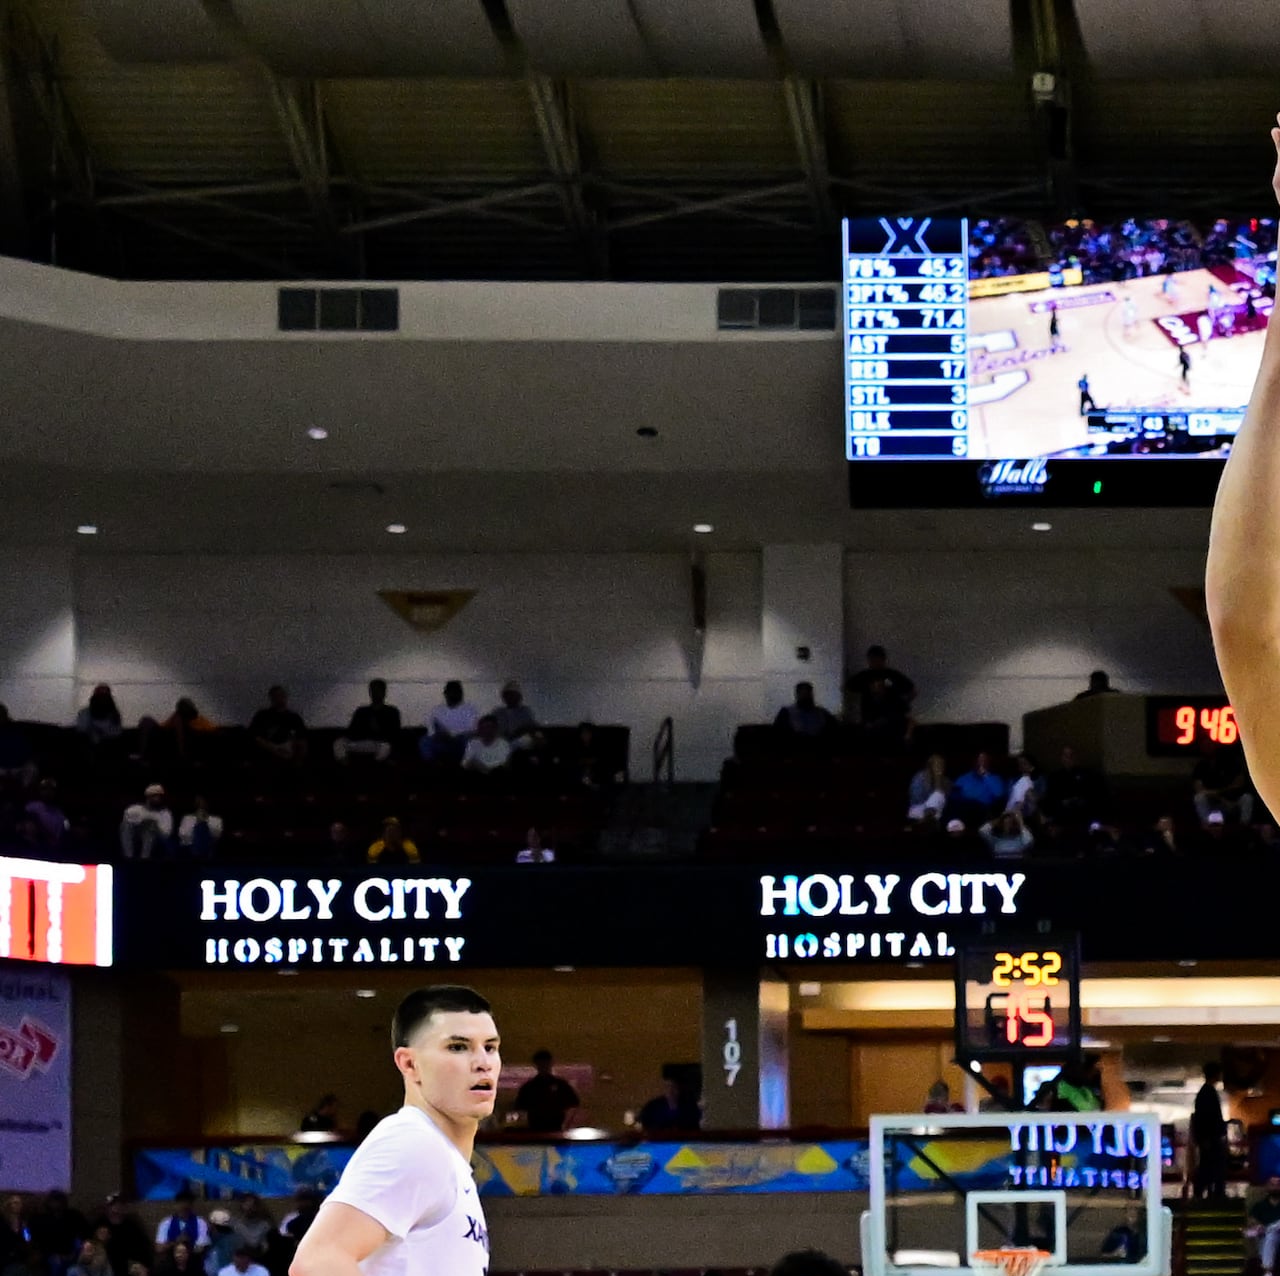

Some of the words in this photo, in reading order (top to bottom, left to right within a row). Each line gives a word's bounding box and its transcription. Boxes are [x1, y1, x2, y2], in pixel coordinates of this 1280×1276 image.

[919, 259, 964, 278] 45.2
[919, 285, 964, 304] 46.2
[921, 310, 965, 329] 71.4
[851, 335, 889, 354] AST
[951, 335, 965, 354] 5
[941, 361, 965, 379] 17
[852, 386, 890, 405] STL
[951, 386, 965, 405] 3
[952, 411, 966, 430] 0
[952, 437, 967, 456] 5
[201, 878, 342, 922] HOLY
[354, 876, 472, 921] CITY
[760, 873, 900, 917] HOLY
[910, 872, 1026, 916] CITY
[205, 936, 465, 965] HOSPITALITY
[766, 931, 956, 959] HOSPITAL
[993, 952, 1061, 987] 2:52
[724, 1019, 741, 1087] 107
